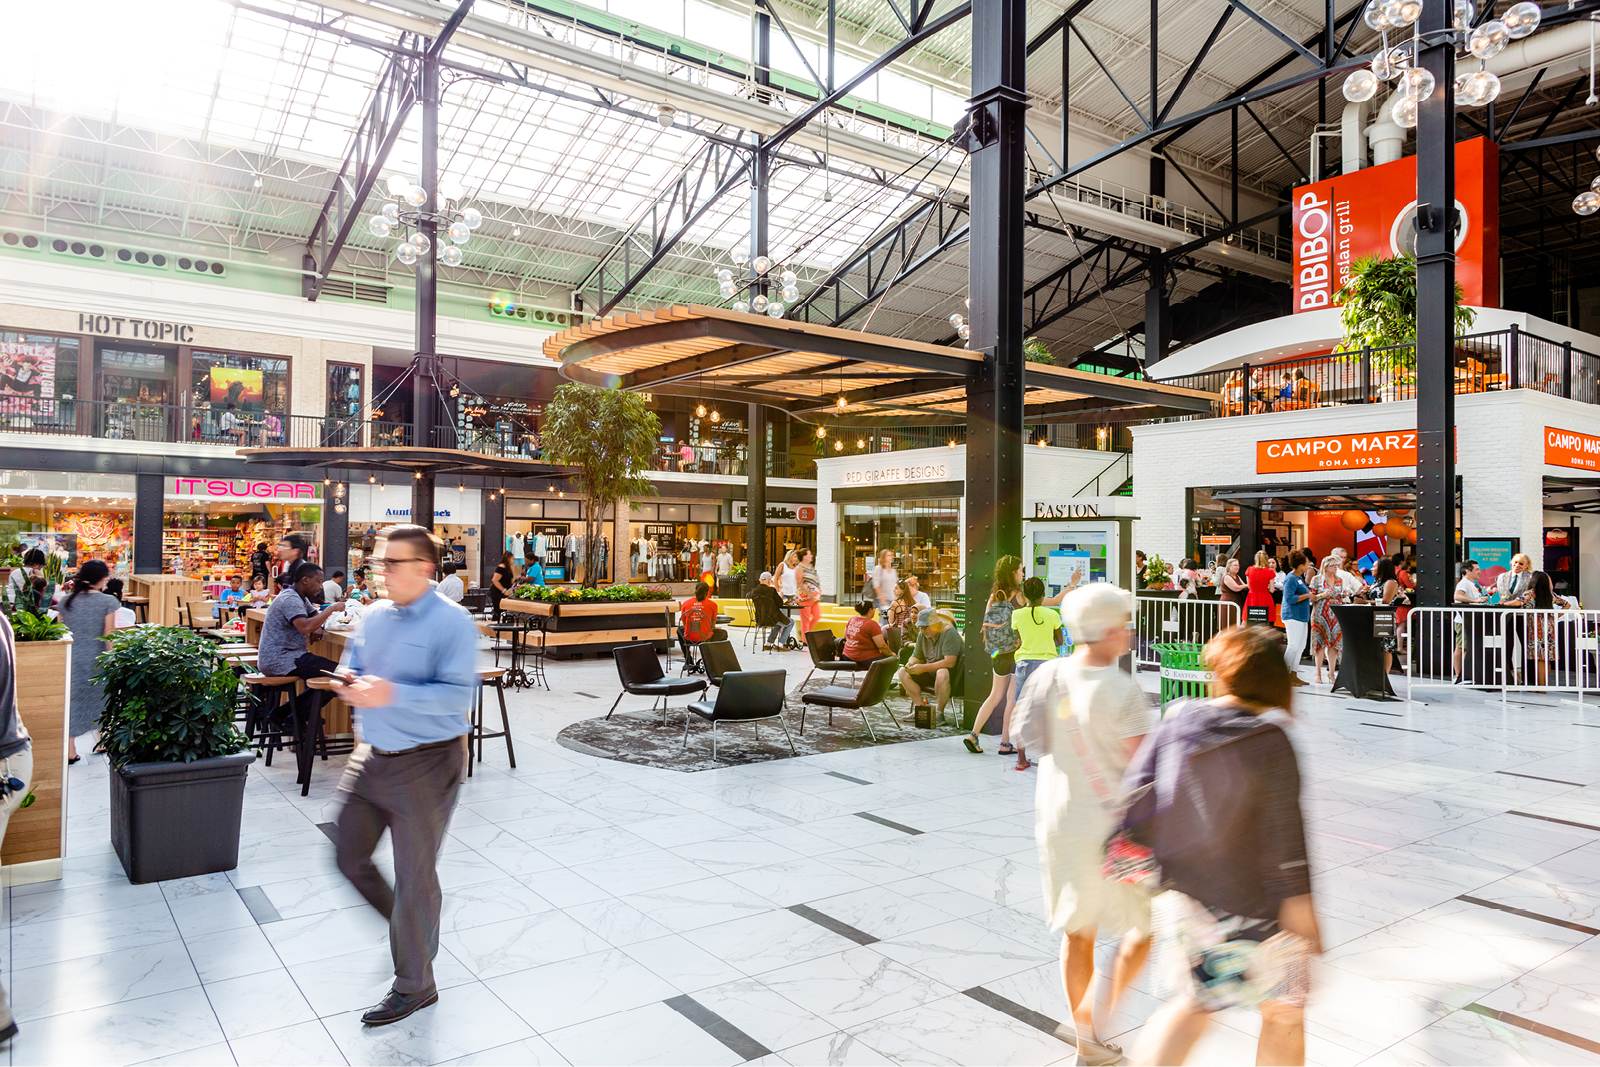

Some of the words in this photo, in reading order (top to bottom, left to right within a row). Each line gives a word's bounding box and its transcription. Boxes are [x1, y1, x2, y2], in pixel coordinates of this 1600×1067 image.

[1336, 200, 1354, 235] grill
[1300, 192, 1328, 310] BIBIBOP
[1338, 238, 1350, 285] asian
[79, 313, 126, 335] HOT
[129, 319, 194, 343] TOPIC
[1266, 439, 1342, 458] CAMPO
[1351, 434, 1416, 453] MARZ
[1548, 431, 1582, 452] CAMPO
[1583, 438, 1600, 454] MAR
[846, 472, 862, 482] RED
[865, 468, 900, 482] GIRAFFE
[904, 464, 946, 479] DESIGNS
[1319, 459, 1349, 467] ROMA
[1355, 457, 1381, 465] 1933
[175, 478, 315, 499] IT'SUGAR
[545, 535, 564, 548] YALTY
